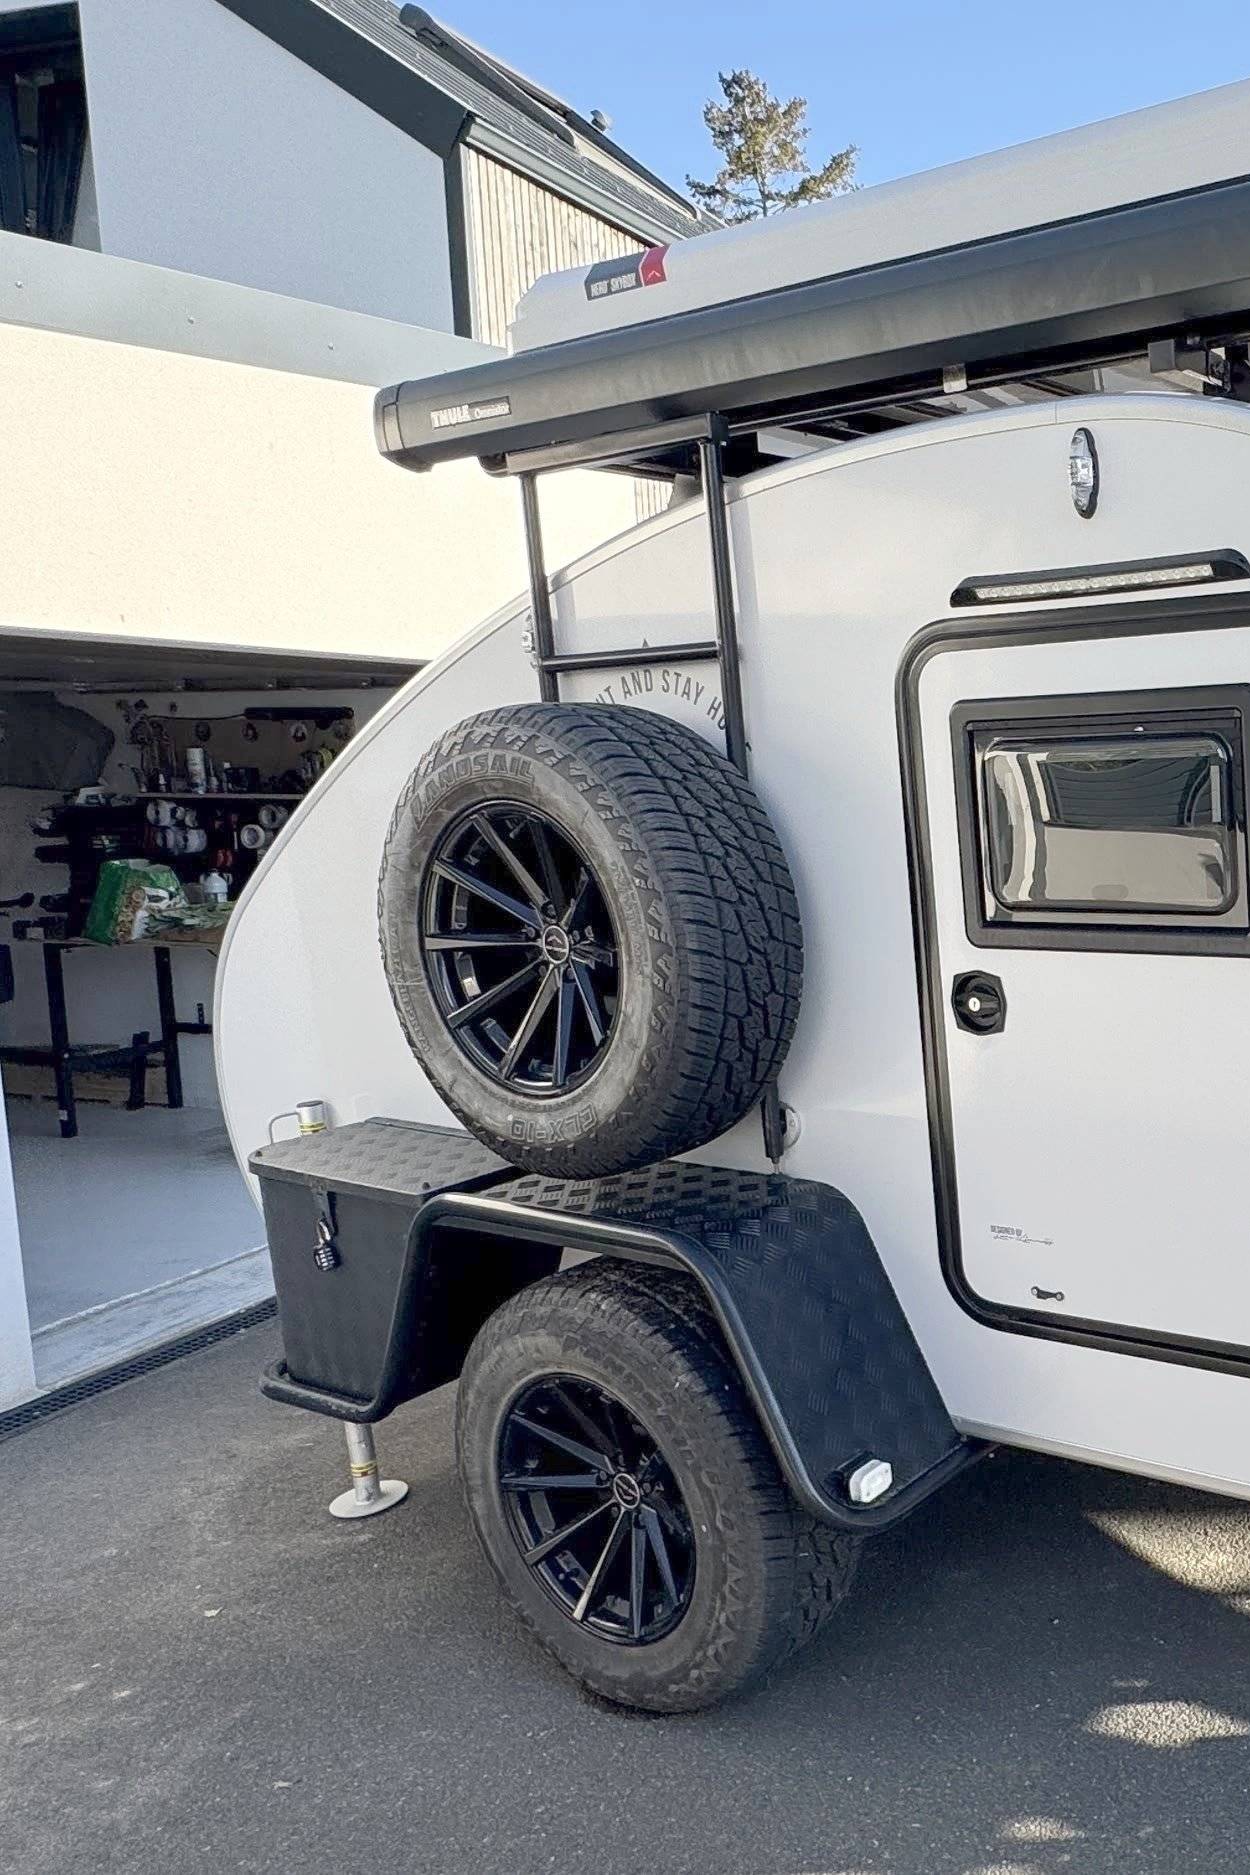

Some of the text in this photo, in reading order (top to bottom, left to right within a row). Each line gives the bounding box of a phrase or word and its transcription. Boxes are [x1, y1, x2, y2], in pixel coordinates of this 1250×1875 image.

[431, 404, 471, 428] THULE
[621, 669, 653, 699] AND
[661, 669, 704, 705] STAY
[409, 750, 535, 832] LANDSAIL
[511, 1102, 597, 1143] CLX-10
